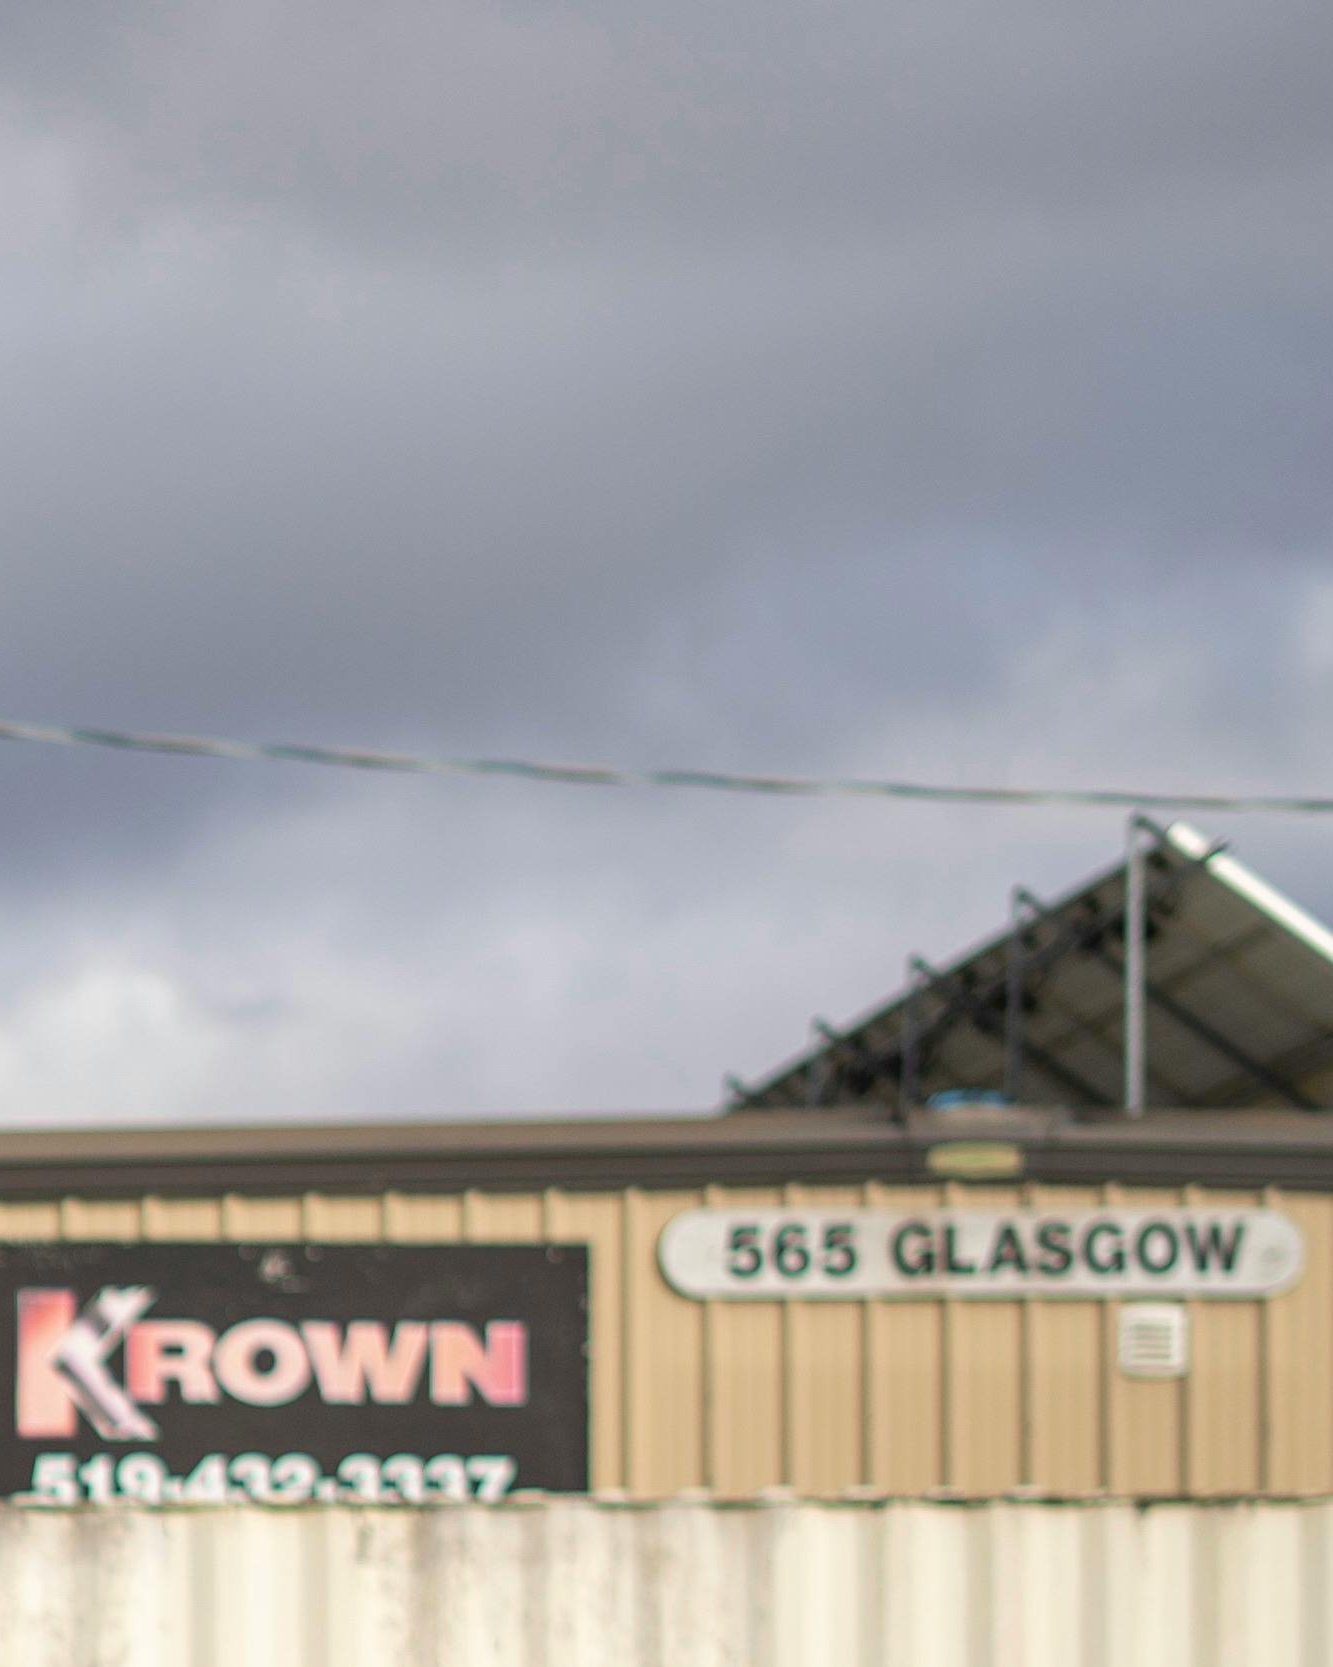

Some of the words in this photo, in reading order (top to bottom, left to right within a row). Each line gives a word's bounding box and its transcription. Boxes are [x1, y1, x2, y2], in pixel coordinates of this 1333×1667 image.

[727, 1222, 858, 1278] 565
[889, 1220, 1247, 1276] GLASGOW
[16, 1286, 528, 1441] KROWN
